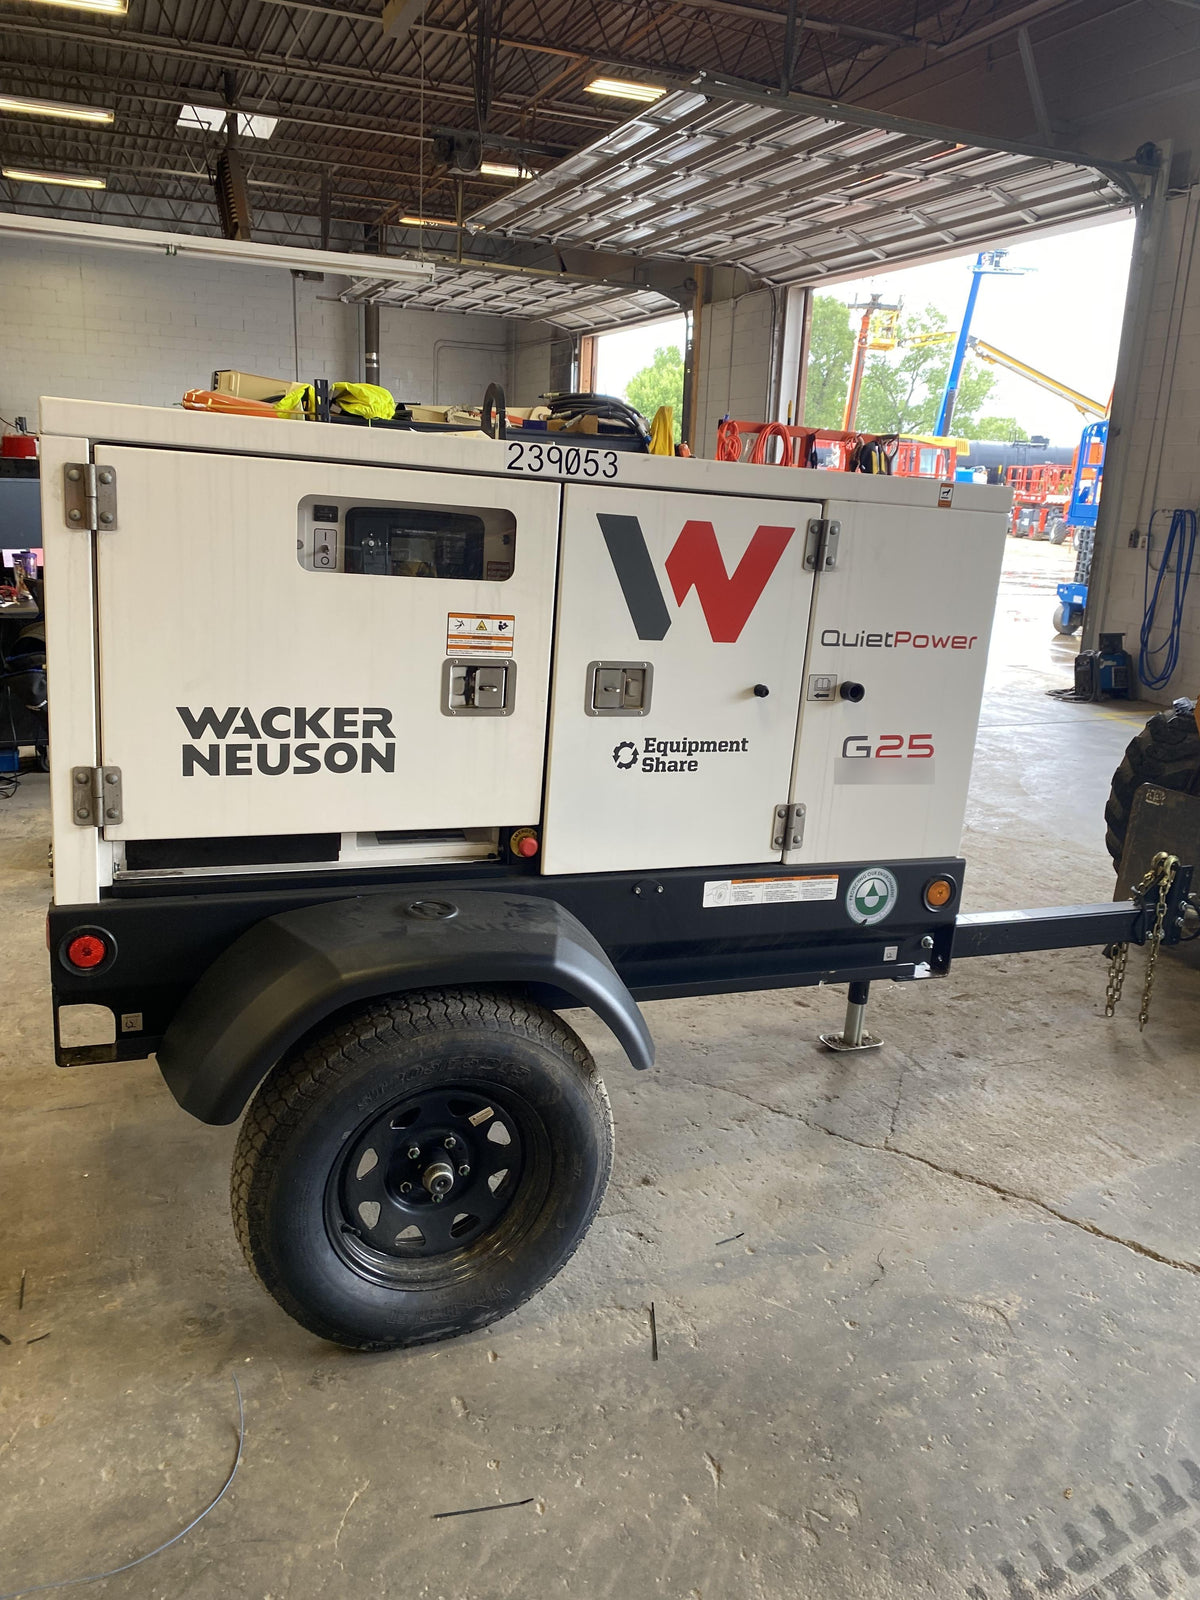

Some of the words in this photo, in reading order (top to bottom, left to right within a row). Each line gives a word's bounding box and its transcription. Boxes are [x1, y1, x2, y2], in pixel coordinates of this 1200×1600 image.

[506, 442, 618, 478] 239053
[820, 629, 978, 650] QuietPower
[175, 706, 397, 740] WACKER
[643, 737, 749, 757] Equipment
[842, 734, 935, 758] G25
[182, 742, 396, 777] NEUSON
[641, 757, 698, 772] Share
[849, 873, 867, 901] PROTECTING
